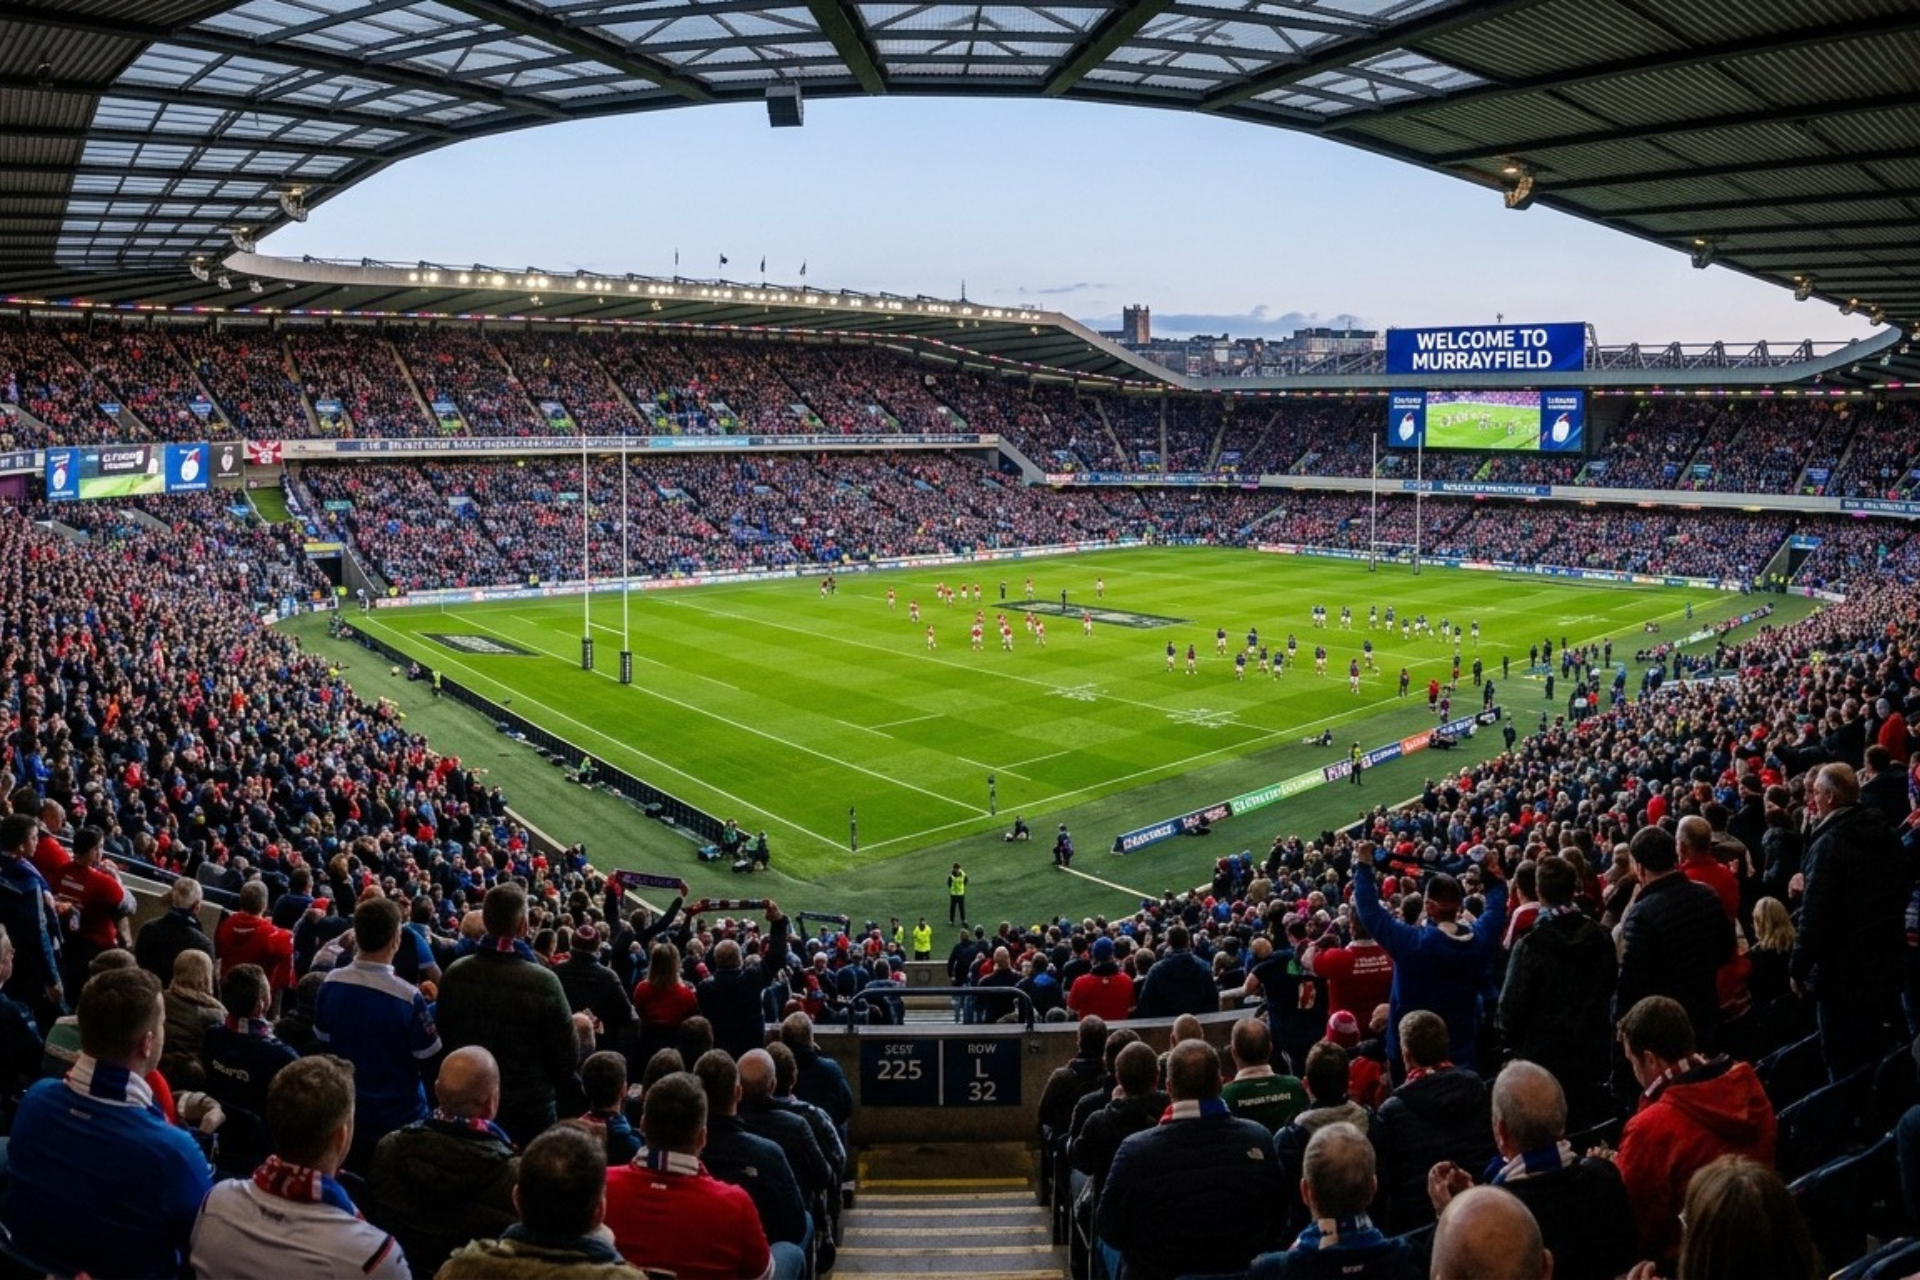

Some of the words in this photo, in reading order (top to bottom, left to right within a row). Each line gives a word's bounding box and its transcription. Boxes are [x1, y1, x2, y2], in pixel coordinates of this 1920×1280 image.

[1417, 329, 1515, 350] WELCOME
[1520, 329, 1548, 348] TO
[1412, 350, 1553, 370] MURRAYFIELD
[968, 1044, 997, 1054] ROW
[877, 1060, 922, 1080] 225
[976, 1058, 989, 1078] L
[968, 1082, 997, 1101] 32
